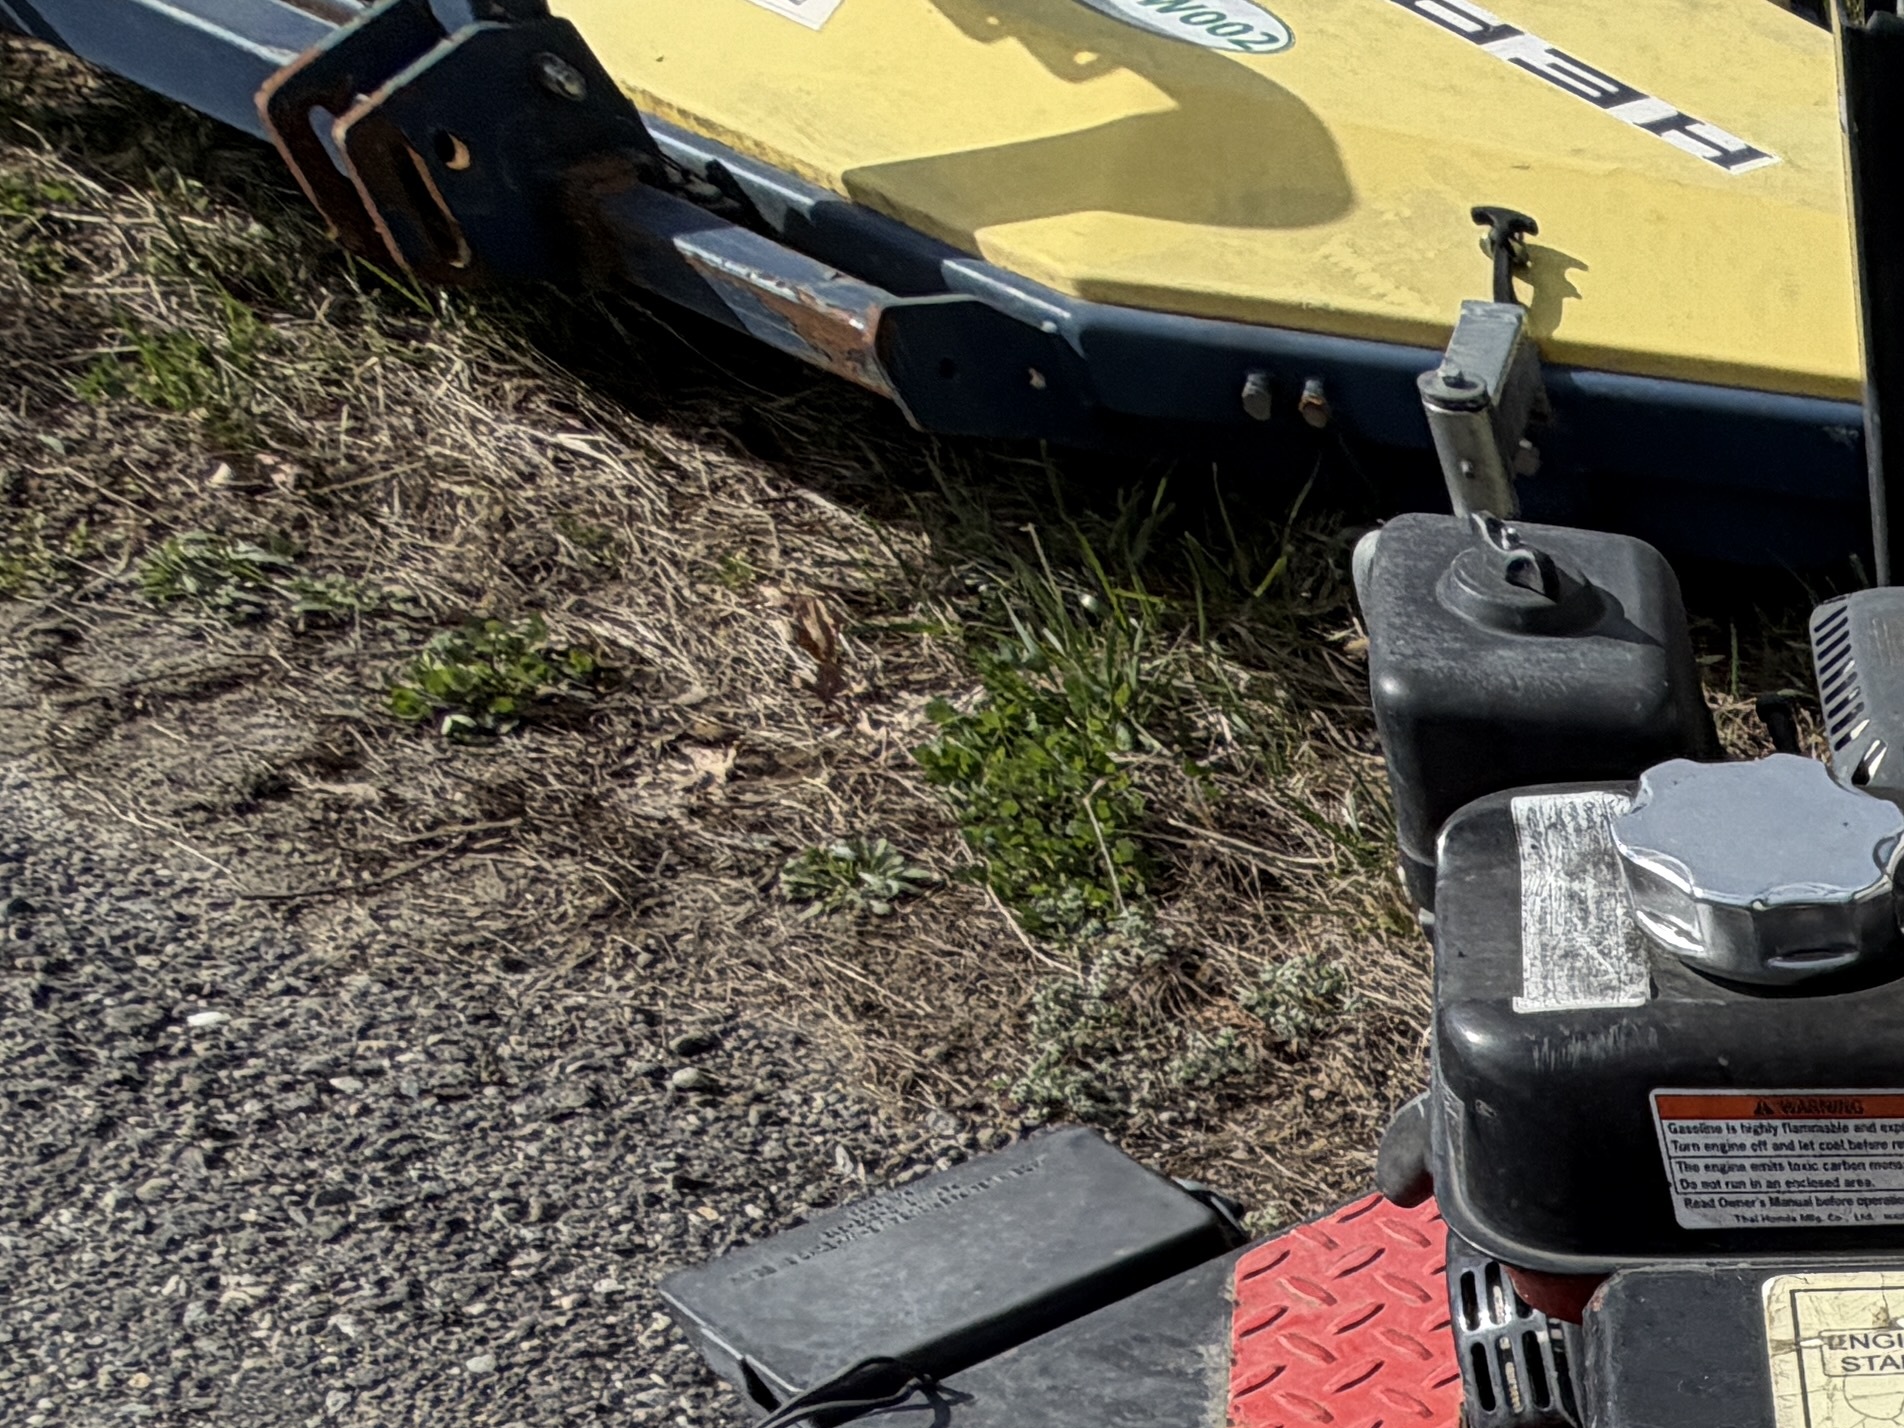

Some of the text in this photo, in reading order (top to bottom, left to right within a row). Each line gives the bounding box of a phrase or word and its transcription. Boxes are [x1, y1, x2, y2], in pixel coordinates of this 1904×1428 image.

[1781, 1100, 1864, 1115] WARNING
[1741, 1122, 1778, 1137] highly
[1854, 1122, 1876, 1134] and
[1670, 1140, 1700, 1151] Turn
[1704, 1140, 1746, 1154] engine
[1772, 1139, 1795, 1151] and
[1676, 1161, 1700, 1173] The
[1704, 1160, 1746, 1175] engine
